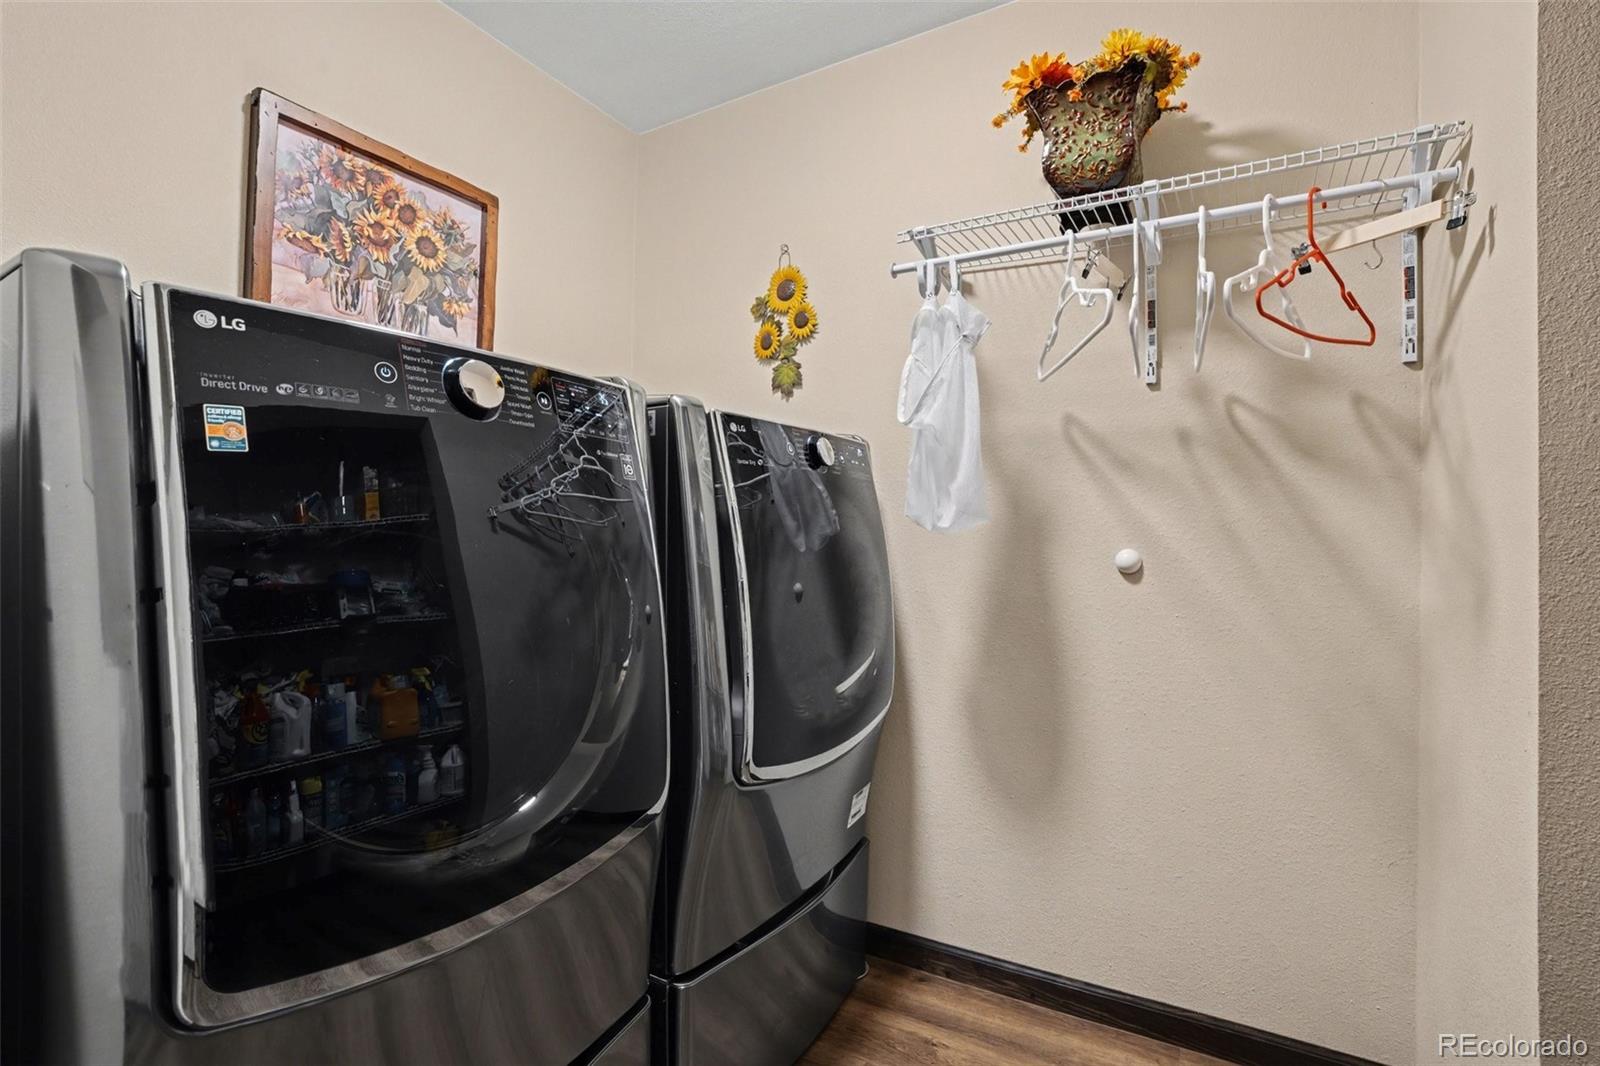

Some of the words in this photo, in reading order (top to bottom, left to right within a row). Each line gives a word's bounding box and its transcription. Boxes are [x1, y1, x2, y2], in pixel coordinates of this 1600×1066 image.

[221, 315, 247, 331] LG
[200, 377, 237, 390] Direct
[238, 381, 269, 393] Drive
[207, 407, 242, 416] CERTIFIED
[737, 424, 746, 432] LG
